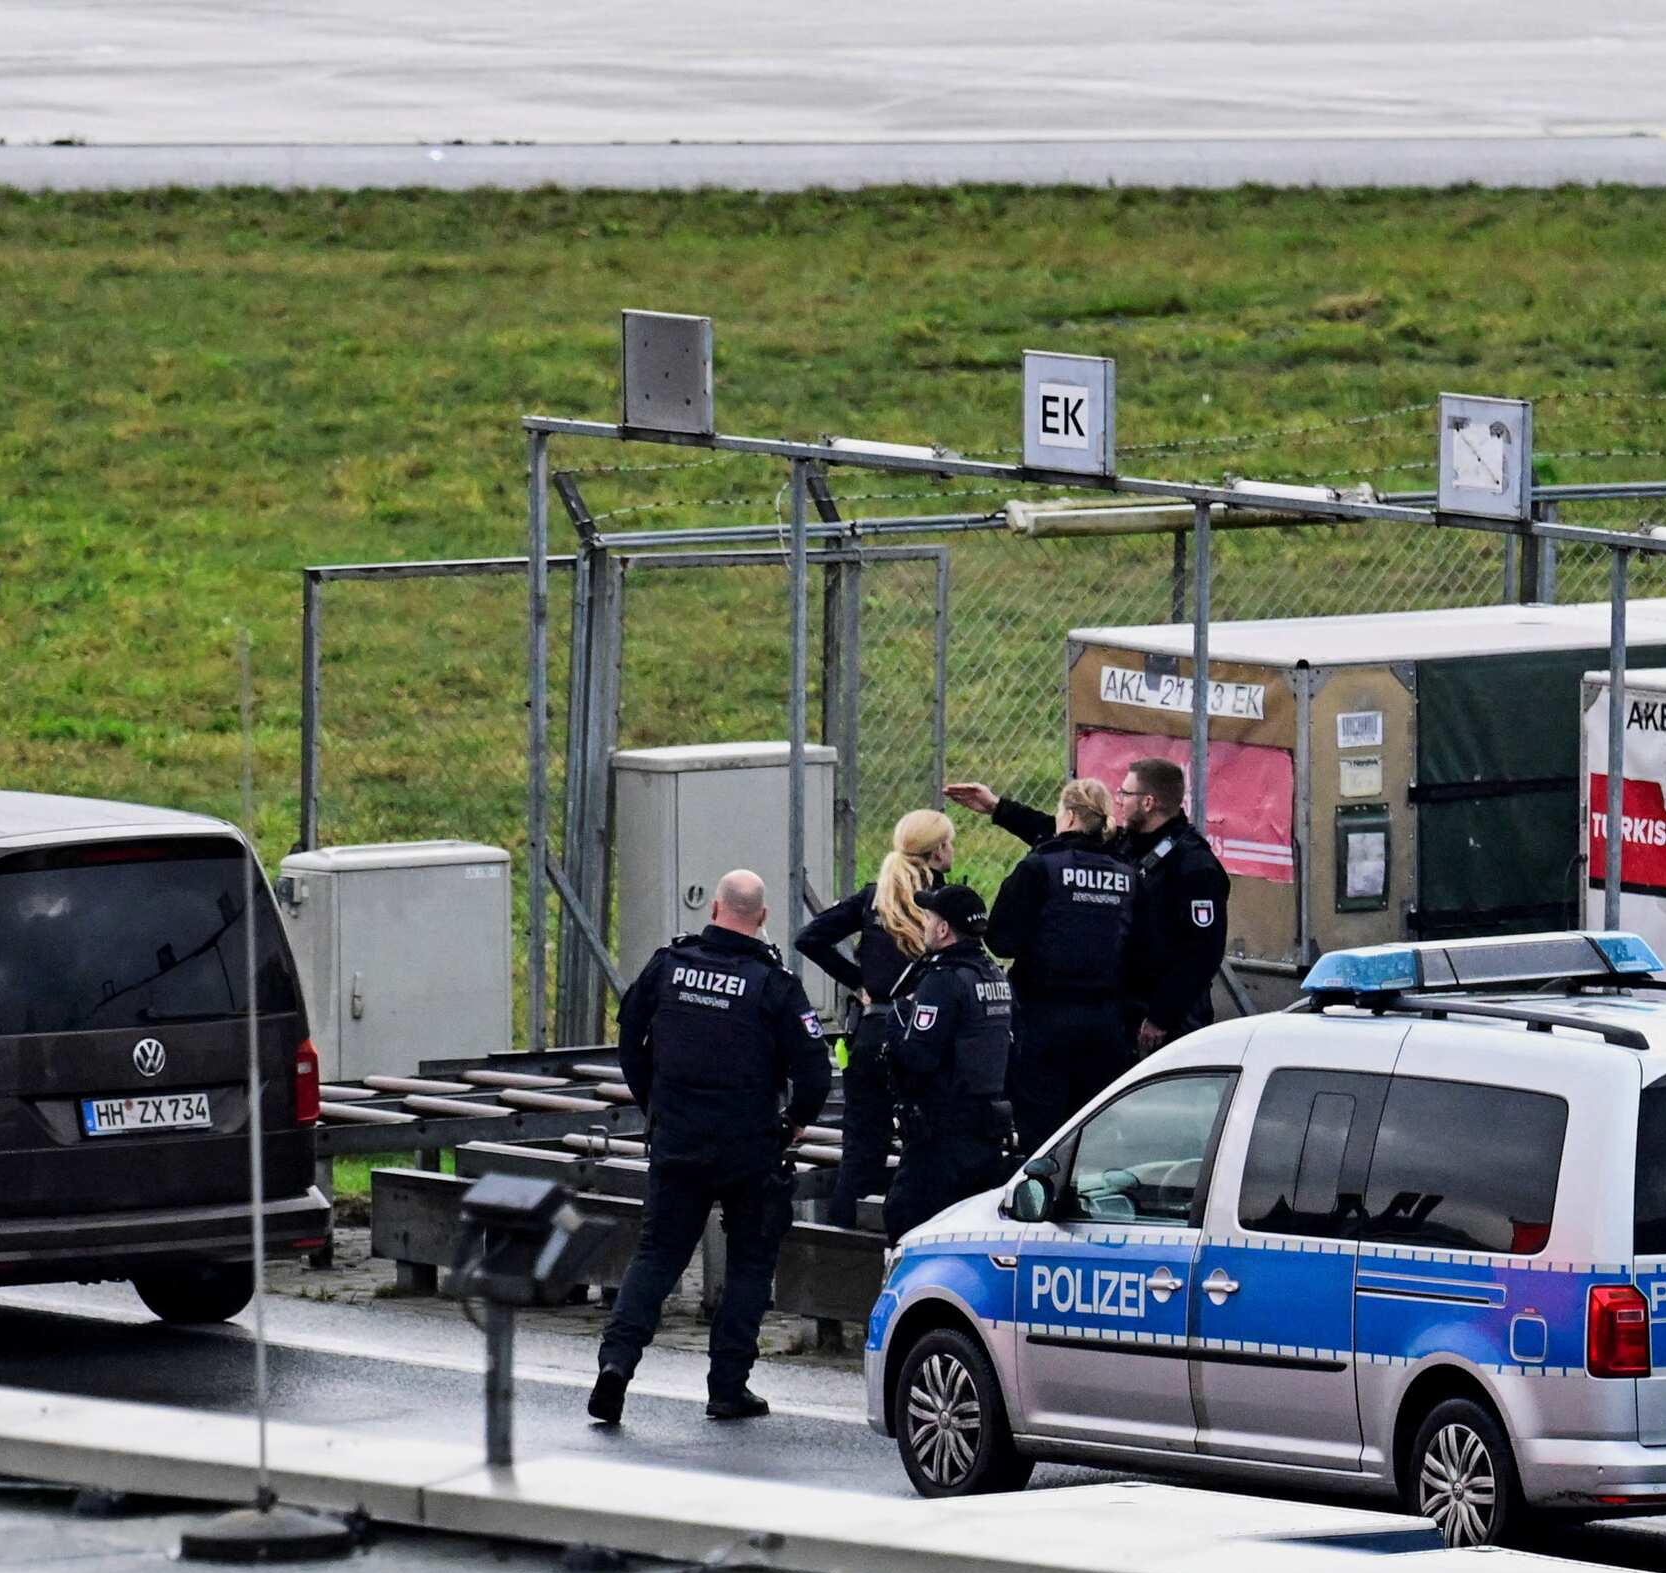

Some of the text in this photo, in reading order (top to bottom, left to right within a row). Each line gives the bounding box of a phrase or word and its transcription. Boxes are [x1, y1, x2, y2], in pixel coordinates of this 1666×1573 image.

[1042, 395, 1085, 437] EK
[1103, 671, 1146, 703] AKL
[1233, 686, 1261, 717] EK
[1062, 868, 1130, 893] POLIZEI
[672, 967, 747, 997] POLIZEI
[96, 1096, 207, 1126] HH ZX 734
[1032, 1264, 1146, 1318] POLIZEI
